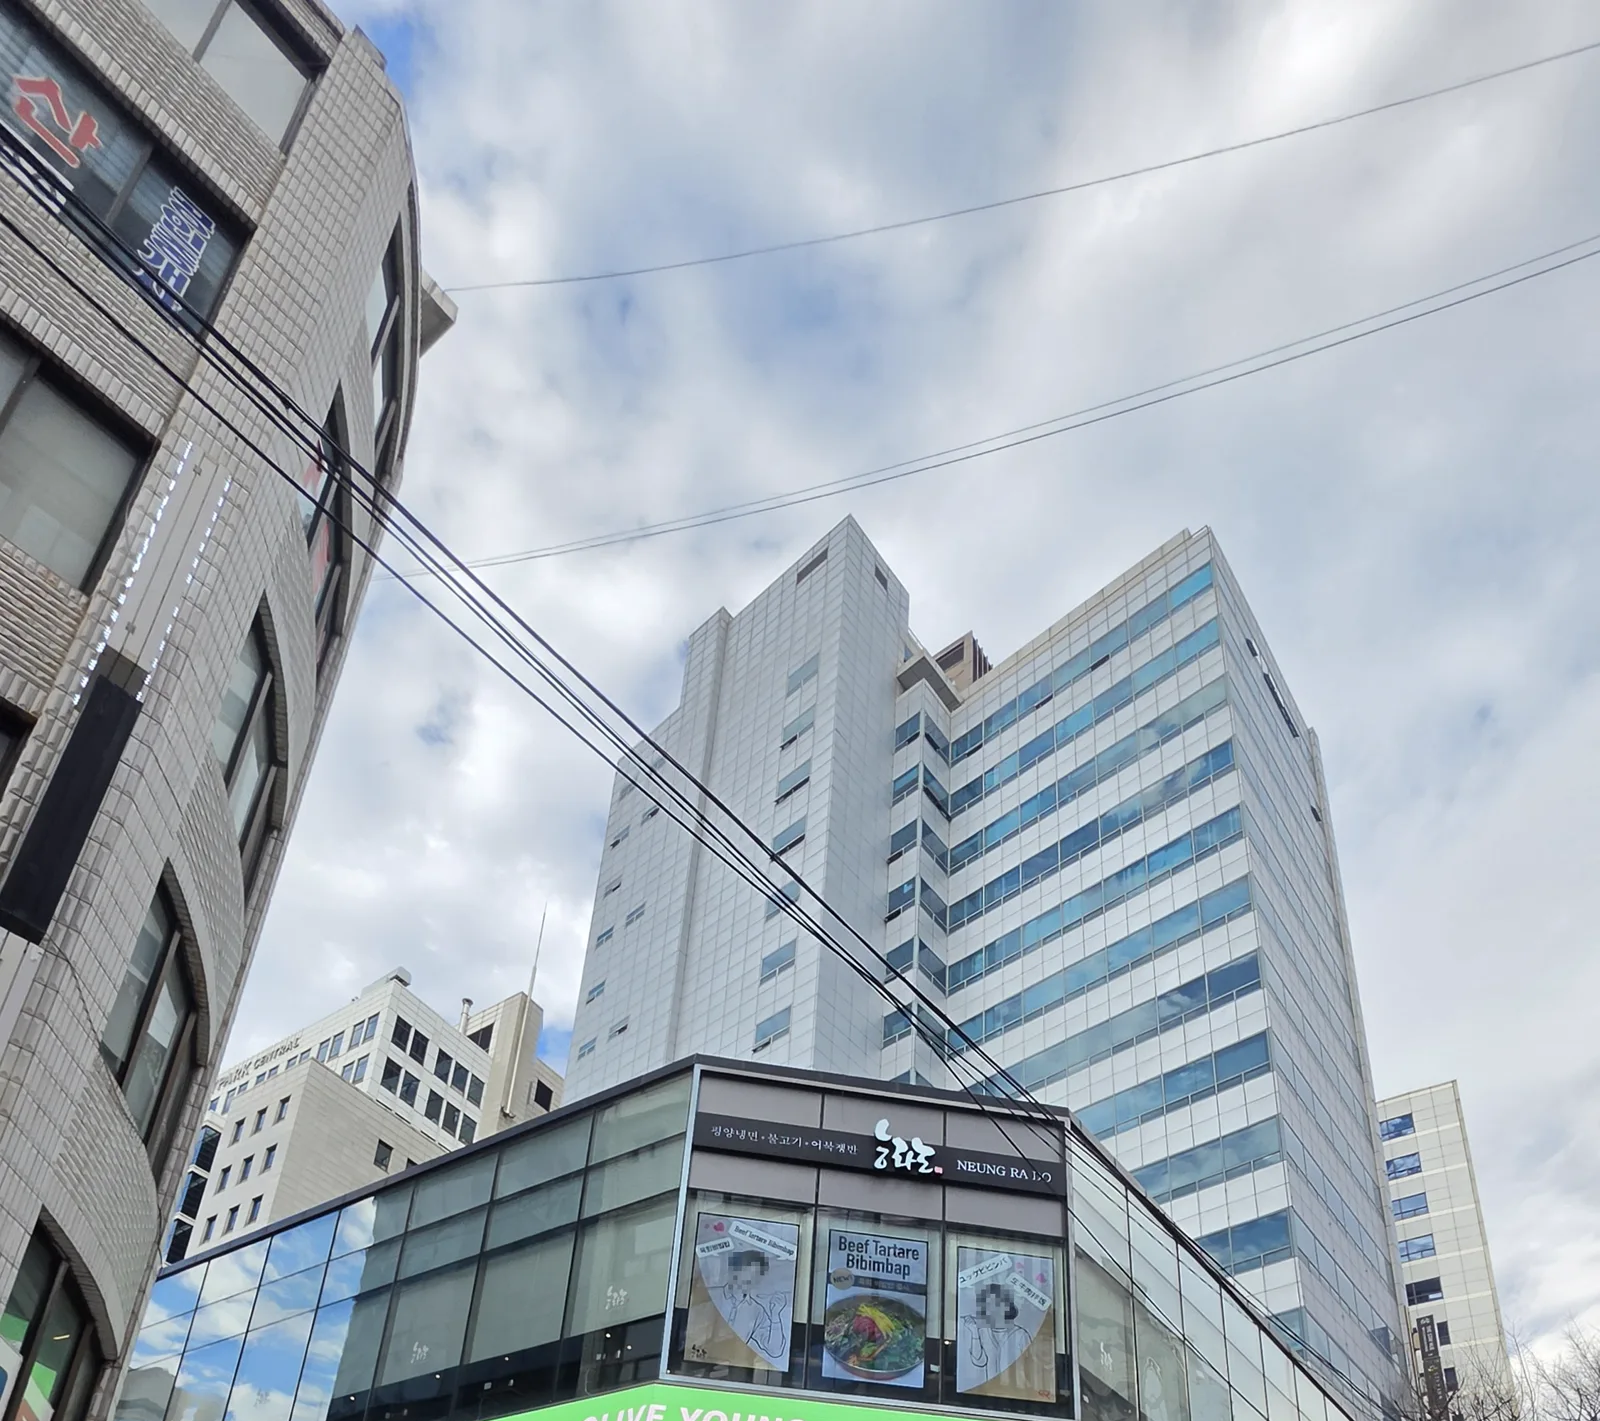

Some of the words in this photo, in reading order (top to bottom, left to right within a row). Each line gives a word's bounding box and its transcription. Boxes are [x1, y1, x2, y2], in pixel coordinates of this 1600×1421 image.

[253, 1038, 301, 1069] CENTRAL
[957, 1160, 1006, 1177] NEUNG
[1010, 1167, 1029, 1180] RA
[839, 1236, 869, 1254] Beef
[872, 1240, 919, 1260] Tartare
[846, 1253, 911, 1280] Bibimbap
